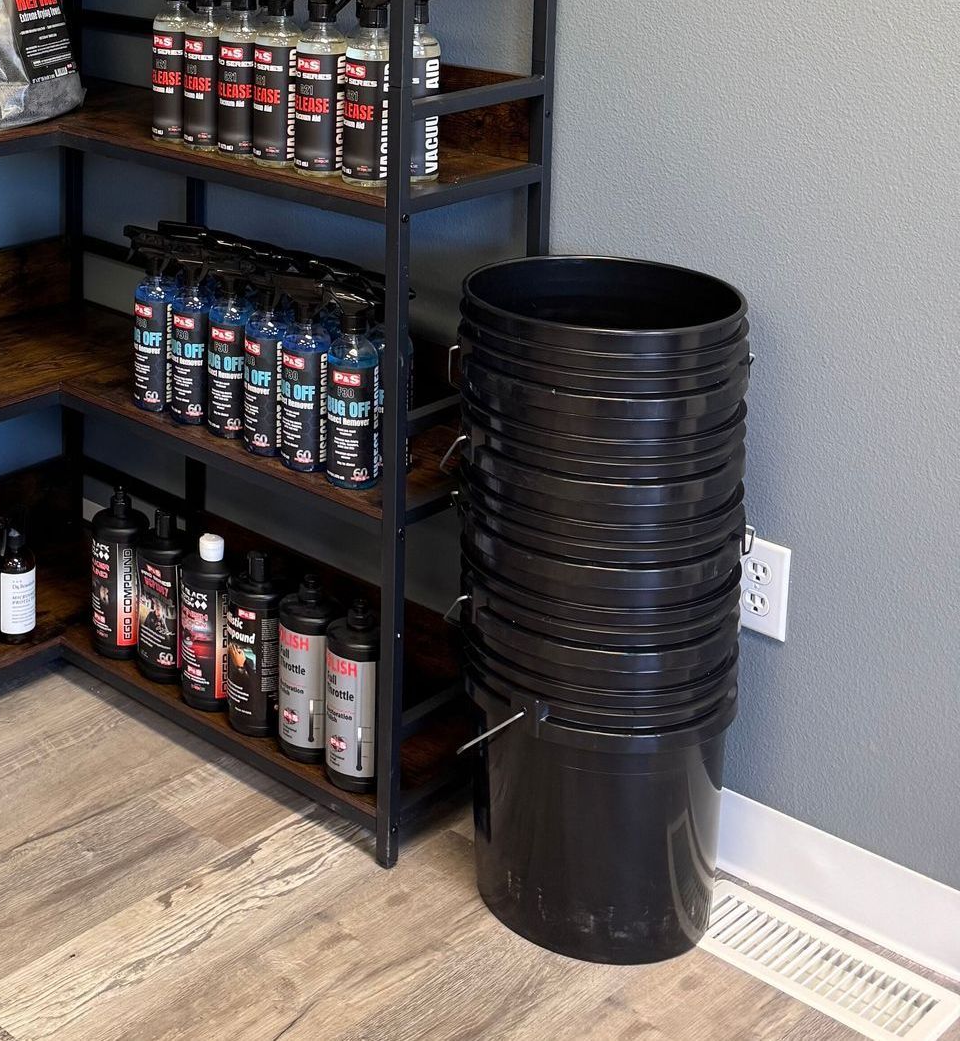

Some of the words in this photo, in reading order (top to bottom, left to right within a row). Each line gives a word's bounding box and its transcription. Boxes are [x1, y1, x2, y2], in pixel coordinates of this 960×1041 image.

[154, 36, 172, 47] P&S
[221, 48, 243, 58] P&S
[298, 60, 320, 71] P&S
[346, 65, 365, 77] P&S
[426, 59, 439, 89] AID
[425, 116, 438, 174] VACUU
[143, 332, 162, 347] OFF
[212, 330, 235, 340] P&S
[224, 357, 244, 371] OFF
[283, 355, 304, 368] P&S
[334, 372, 360, 385] P&S
[145, 391, 158, 400] 60
[294, 386, 315, 401] OFF
[328, 398, 345, 415] BUG
[349, 401, 371, 417] OFF
[227, 418, 240, 427] 60
[342, 417, 370, 427] Remover
[353, 468, 368, 478] 60
[123, 549, 132, 613] COMPOUND
[124, 618, 132, 640] EGO
